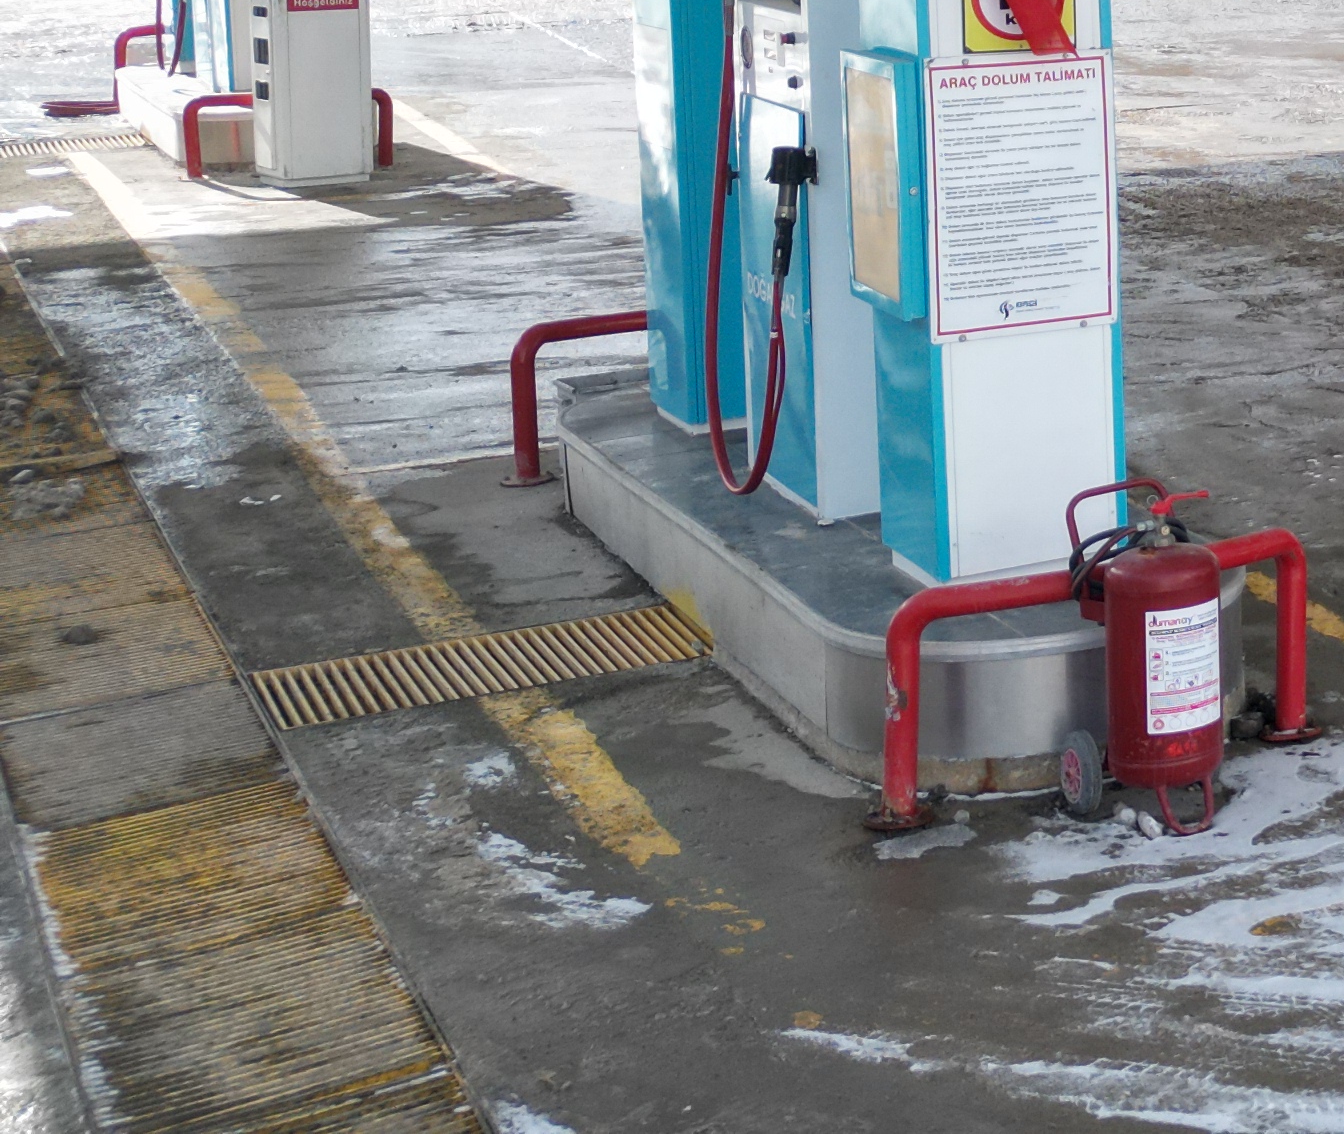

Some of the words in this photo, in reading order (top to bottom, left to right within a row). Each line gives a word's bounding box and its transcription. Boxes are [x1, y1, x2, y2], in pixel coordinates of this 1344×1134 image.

[939, 76, 977, 90] ARAÇ
[981, 72, 1031, 87] DOLUM
[1035, 67, 1096, 83] TALİMATI
